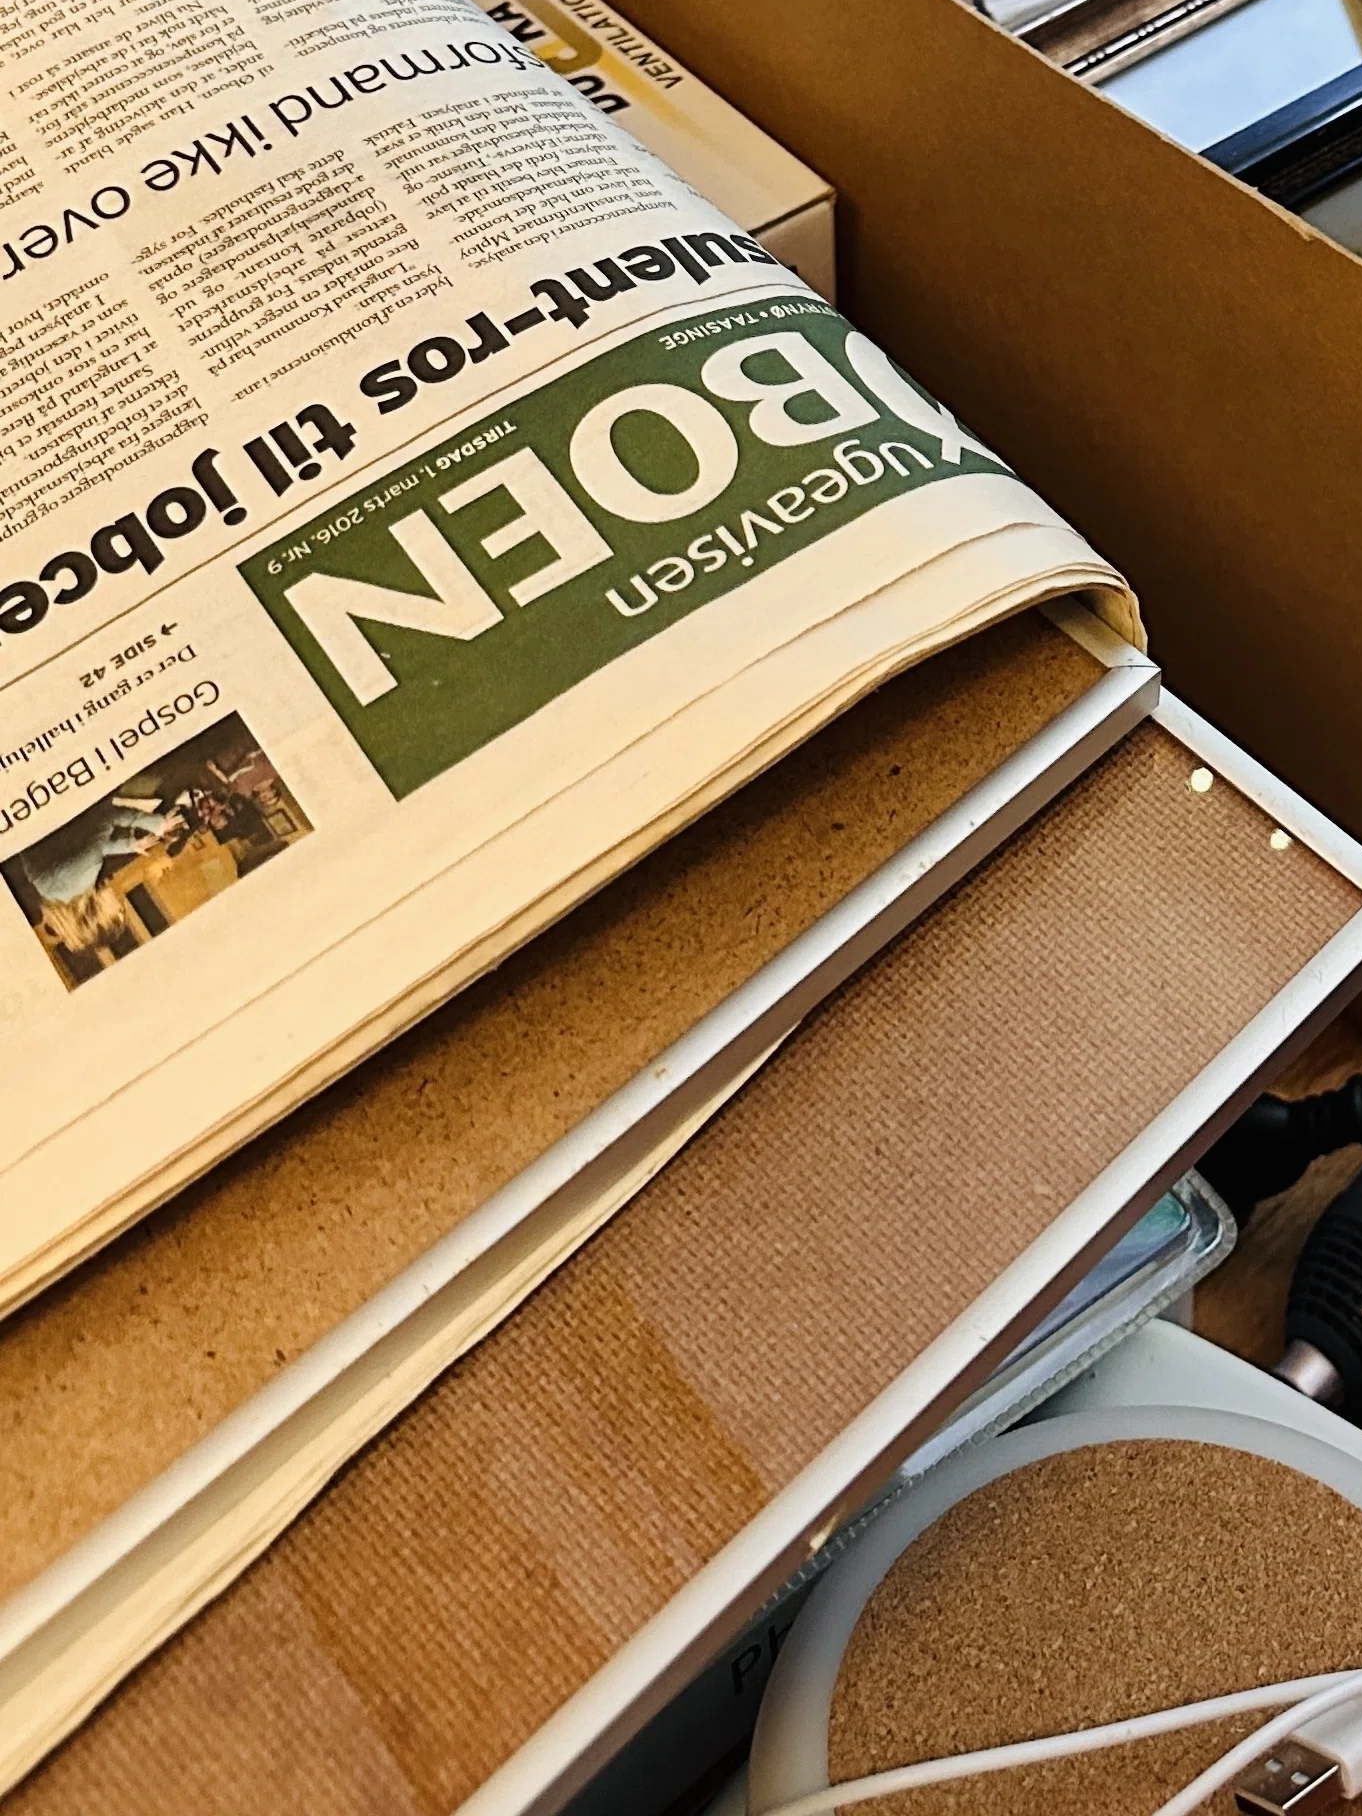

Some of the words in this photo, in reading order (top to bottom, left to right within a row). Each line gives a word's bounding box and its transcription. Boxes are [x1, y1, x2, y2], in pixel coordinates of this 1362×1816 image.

[197, 72, 255, 98] Øboen.
[256, 63, 276, 79] til
[158, 99, 195, 122] Han
[115, 118, 156, 146] sagde
[63, 143, 113, 178] blandt
[140, 115, 272, 190] ikke
[293, 169, 330, 196] gode
[331, 161, 356, 178] der
[195, 173, 365, 268] a-dagpengemodtagere)
[227, 191, 293, 230] resultater
[307, 195, 388, 244] (jobparate
[1, 186, 128, 279] over
[180, 185, 377, 292] dannelseshjælpsmodtagere
[210, 224, 227, 243] af
[344, 212, 399, 247] tættest
[350, 220, 408, 259] gerende
[136, 233, 212, 276] indsatsen,
[231, 242, 303, 282] kontant-
[315, 239, 336, 262] på
[385, 237, 420, 259] flere
[147, 261, 194, 293] opnås
[294, 254, 350, 285] indsats.
[322, 254, 384, 292] områder
[41, 272, 110, 310] områder,
[154, 288, 178, 305] og
[177, 258, 307, 336] arbejdsmarkedet
[200, 281, 225, 299] og
[266, 283, 294, 303] For
[301, 287, 320, 304] en
[413, 274, 453, 300] lyder
[97, 299, 129, 324] som
[166, 297, 196, 317] ud-
[254, 299, 299, 333] meget
[379, 304, 395, 321] af
[394, 294, 413, 310] en
[6, 310, 44, 336] hvor
[28, 300, 92, 343] analysen
[80, 319, 96, 334] er
[94, 312, 140, 347] tivitet
[187, 294, 264, 347] grupperne
[658, 312, 759, 351] TAASINGE
[7, 328, 79, 372] væsentlig
[84, 339, 94, 352] i
[122, 326, 150, 347] har
[142, 340, 158, 357] at
[197, 325, 251, 358] velfun-
[269, 311, 383, 381] konklusionerne
[52, 345, 84, 368] den
[99, 343, 119, 359] en
[59, 350, 141, 406] Langeland
[66, 355, 97, 378] stor
[100, 363, 153, 404] Samlet
[117, 369, 180, 410] fekterne
[161, 383, 191, 404] der
[228, 379, 262, 401] ana-
[261, 376, 271, 389] i
[35, 396, 99, 438] fremstår
[37, 394, 57, 419] på
[98, 405, 116, 424] af
[140, 396, 200, 437] længere
[147, 398, 163, 416] et
[16, 434, 33, 452] et
[117, 432, 141, 450] fra
[242, 399, 354, 496] til
[434, 417, 517, 472] TIRSDAG
[59, 412, 211, 506] dagpengemodtagere
[362, 472, 419, 511] marts
[36, 500, 59, 518] og
[309, 505, 363, 541] 2016.
[603, 437, 934, 621] Ugeavisen
[280, 538, 310, 557] Nr.
[264, 556, 281, 575] 9
[109, 633, 157, 670] SIDE
[156, 643, 197, 673] Der
[78, 664, 108, 690] 42
[134, 668, 155, 687] er
[81, 676, 132, 719] gang
[109, 679, 217, 760] Gospel
[94, 747, 110, 770] i
